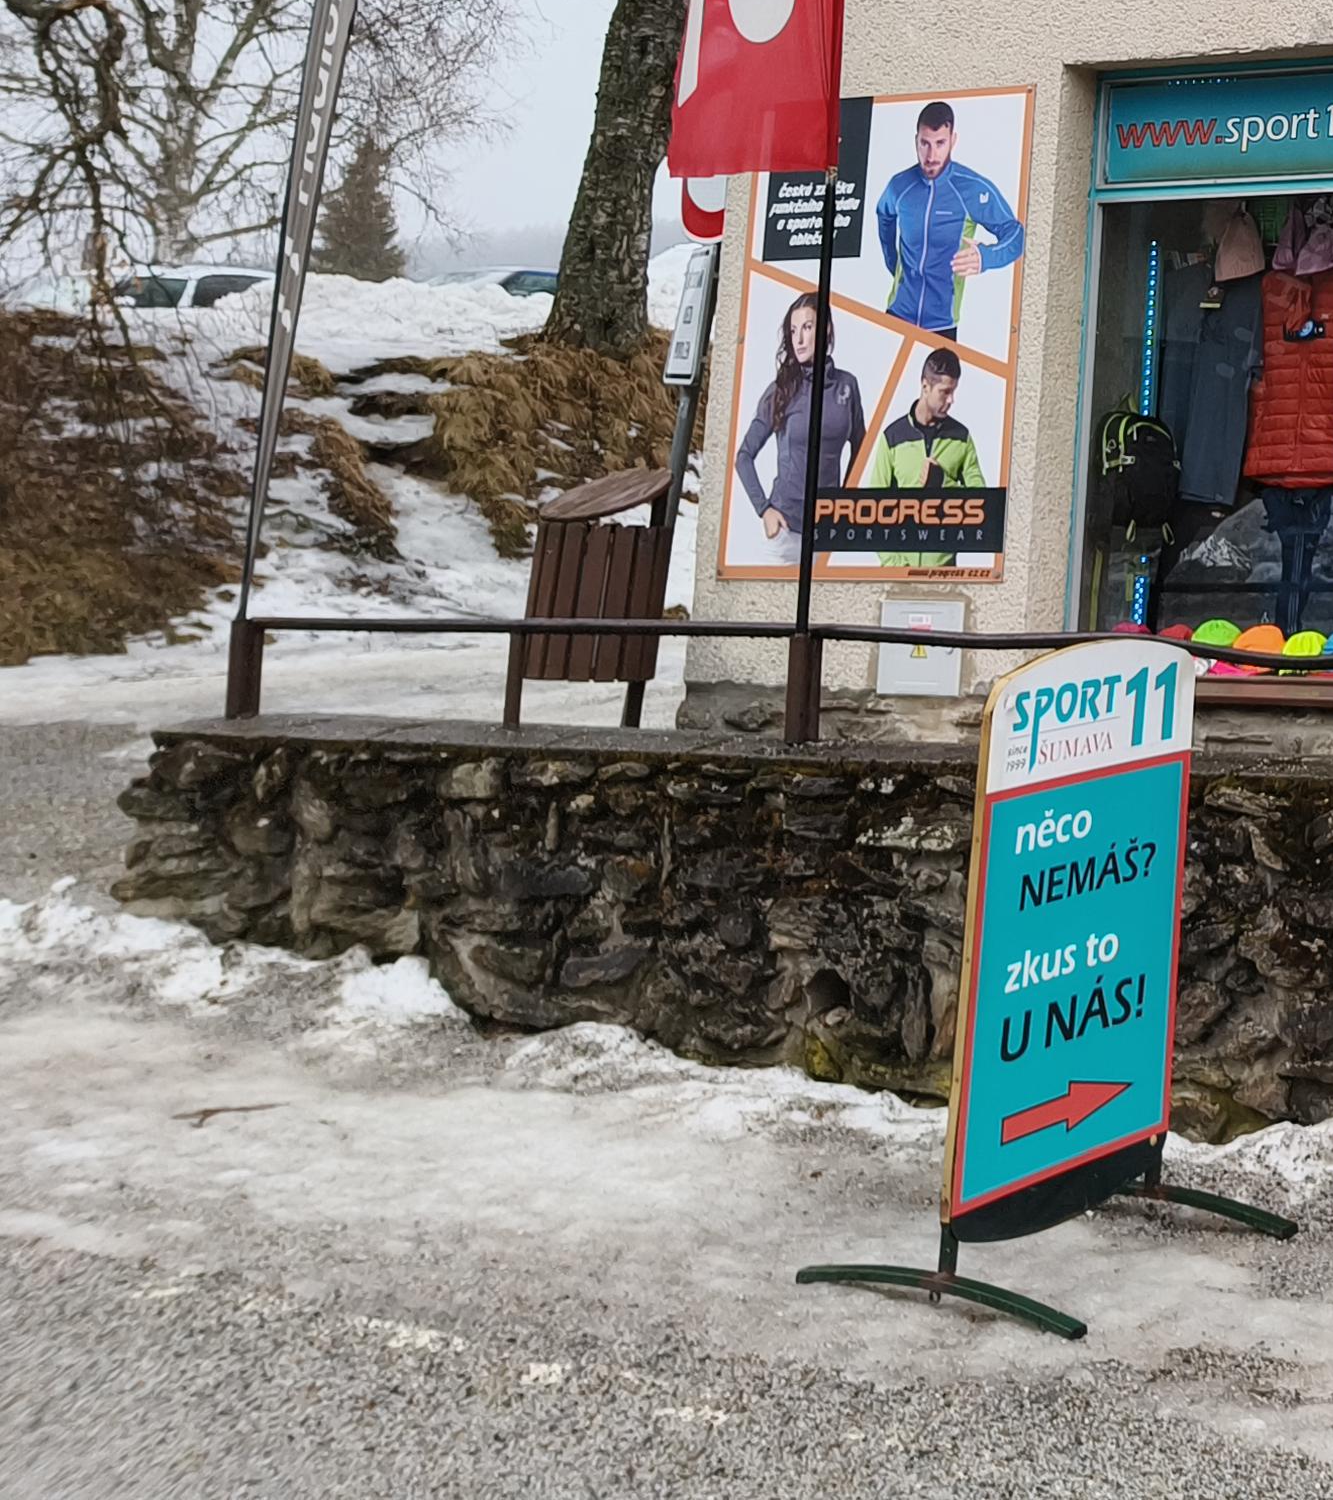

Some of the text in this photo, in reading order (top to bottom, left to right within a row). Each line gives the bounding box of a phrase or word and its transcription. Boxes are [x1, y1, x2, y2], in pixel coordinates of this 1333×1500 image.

[813, 528, 985, 542] SPORTSWEAR
[814, 498, 985, 526] PROGRESS
[1012, 660, 1179, 775] SPORT 11
[1005, 758, 1027, 773] 1999
[1006, 731, 1114, 766] since ŠUMAVA
[1014, 809, 1093, 856] něco
[1018, 835, 1158, 912] NEMÁŠ?
[1003, 931, 1120, 994] zkus to
[1000, 973, 1148, 1063] U NÁS!
